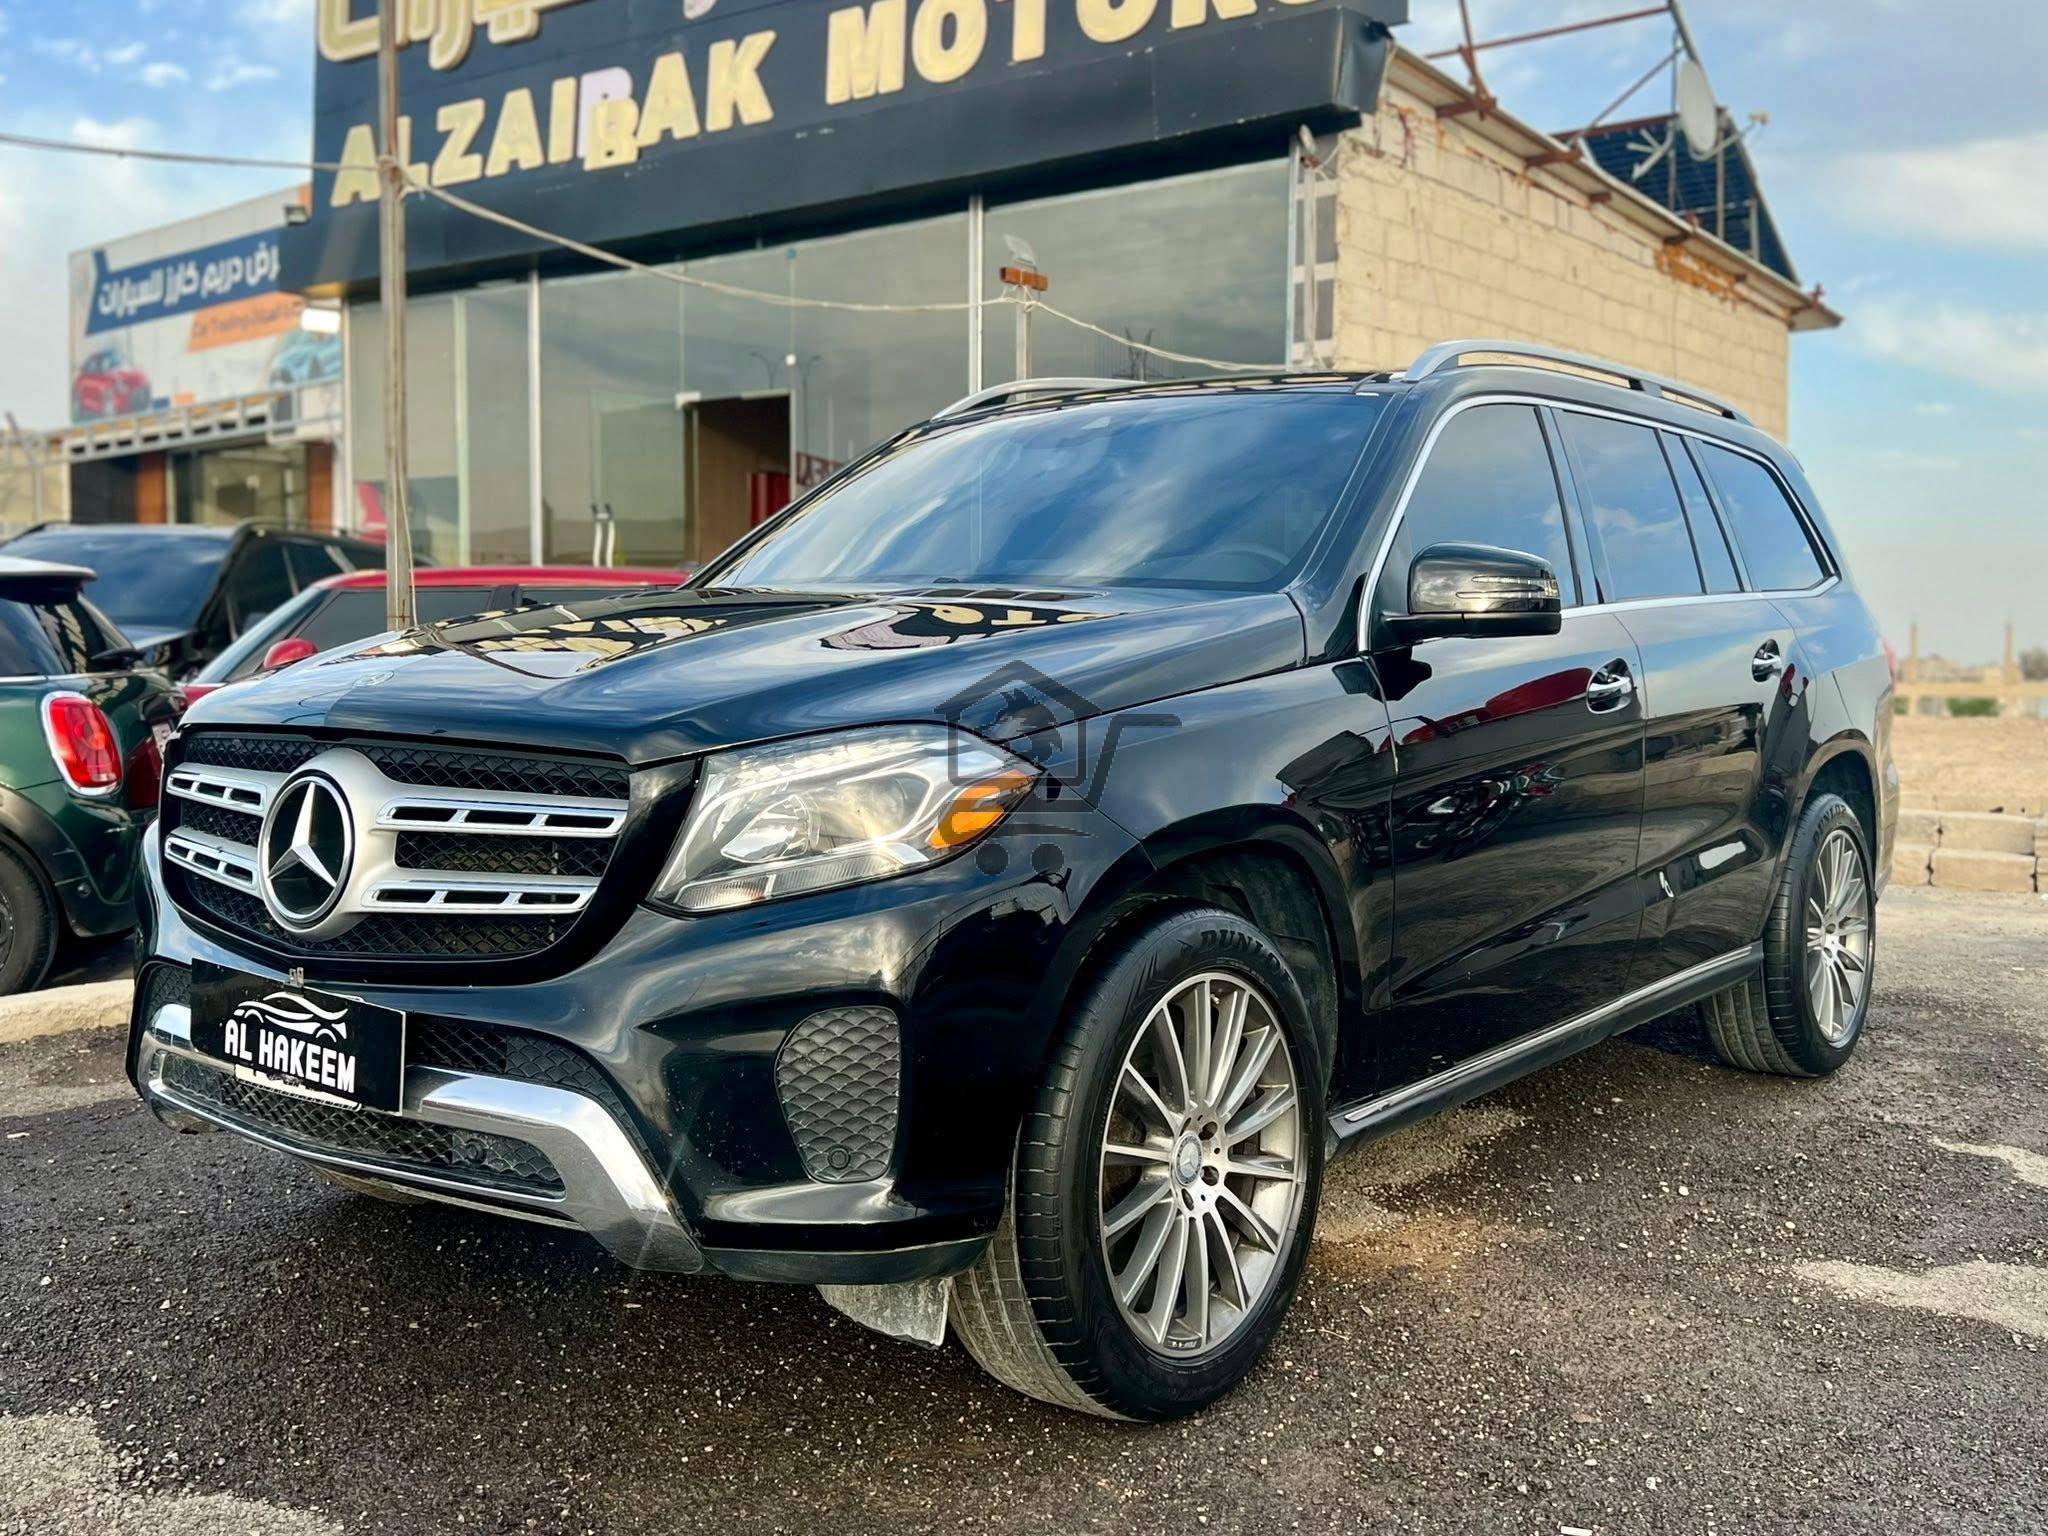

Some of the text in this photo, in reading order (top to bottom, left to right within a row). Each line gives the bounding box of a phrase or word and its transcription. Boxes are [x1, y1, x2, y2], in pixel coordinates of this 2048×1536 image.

[330, 31, 777, 208] ALZAIBAK
[825, 0, 1308, 105] MOTO
[224, 1018, 356, 1093] AL HAKEEM
